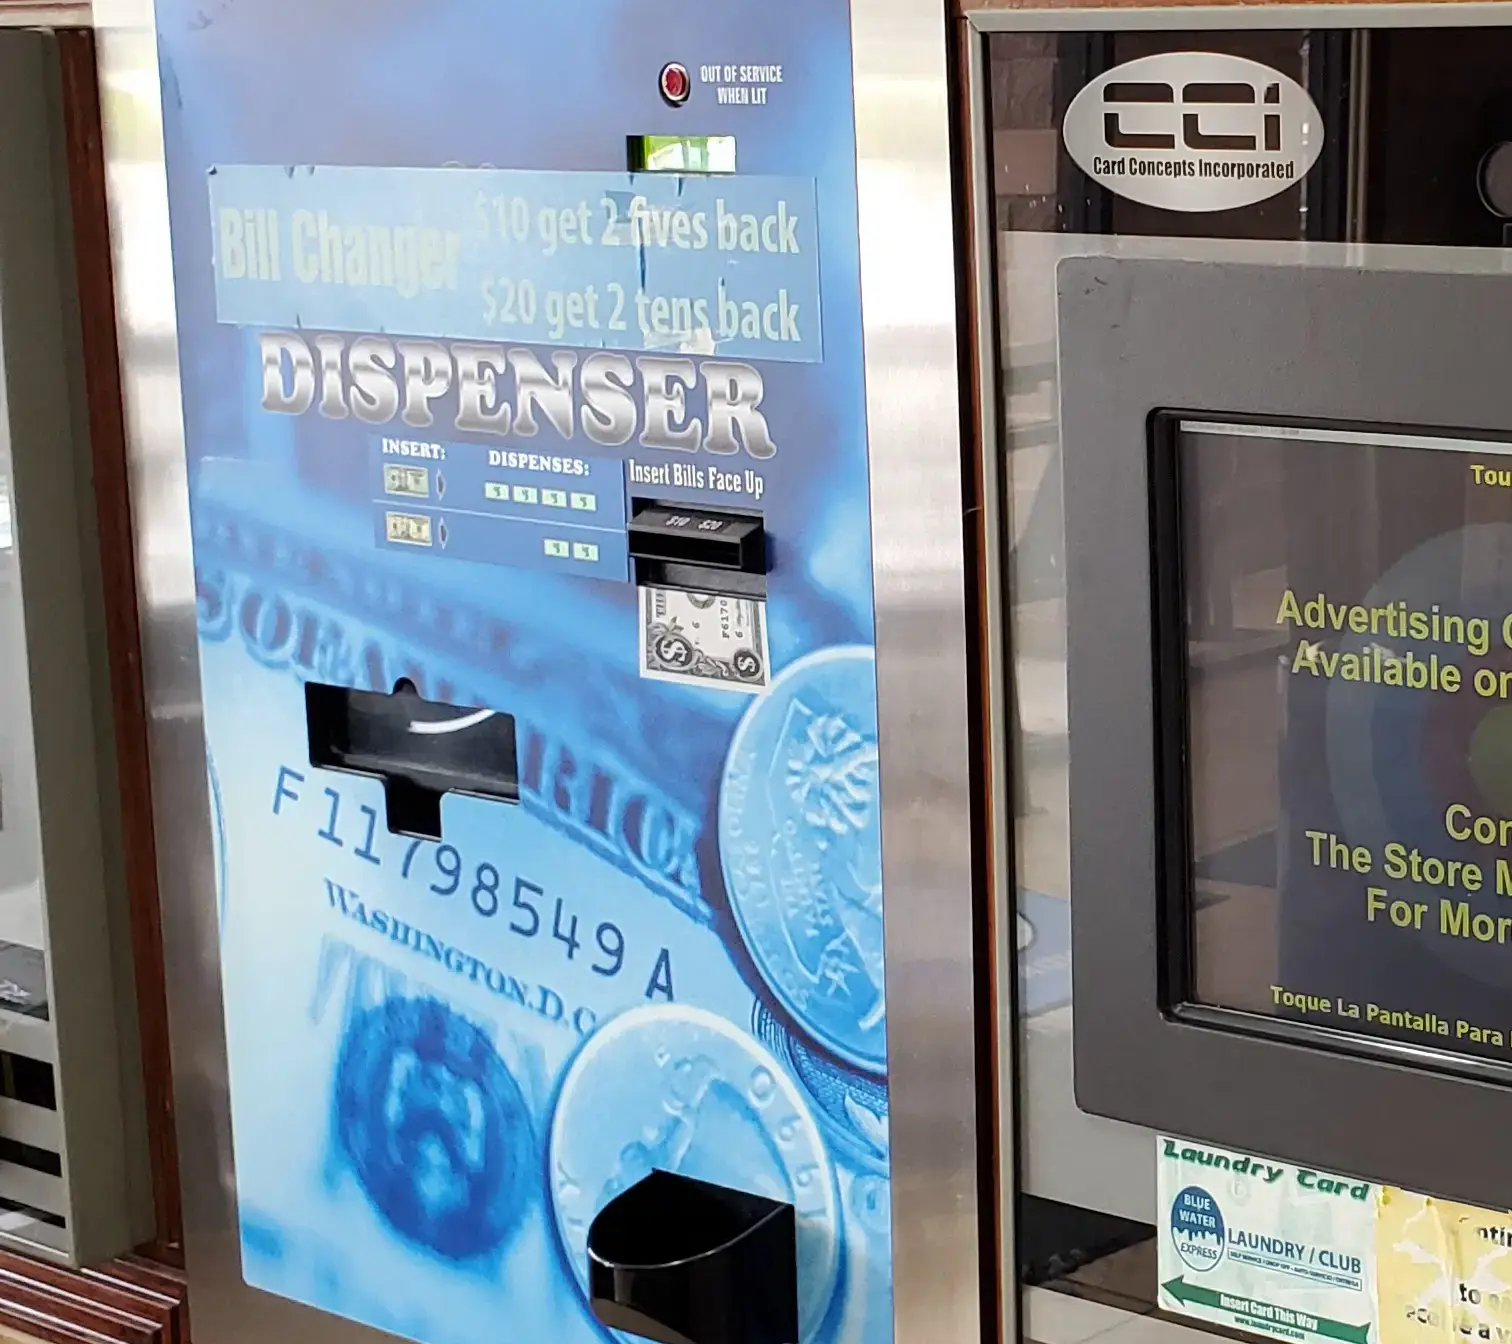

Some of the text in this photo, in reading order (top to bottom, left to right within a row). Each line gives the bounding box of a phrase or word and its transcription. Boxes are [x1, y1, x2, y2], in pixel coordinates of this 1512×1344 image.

[700, 65, 784, 84] OUT OF SERVICE
[717, 87, 767, 105] WHEN LIT
[1093, 156, 1295, 180] Card Concepts Incorporated
[474, 191, 800, 256] $10 get 2 fives back
[219, 207, 462, 299] Bill Changer
[481, 276, 802, 343] $20 get 2 tens back
[258, 330, 778, 458] DISPENSER
[382, 437, 591, 477] INSERT: DISPENSES:
[628, 458, 764, 500] Insert Bills Face Up
[1276, 589, 1491, 654] Advertising
[1291, 640, 1462, 694] Available
[1305, 830, 1373, 873] The
[1383, 843, 1483, 892] Store
[1366, 888, 1429, 930] For
[1270, 986, 1332, 1014] Toque
[1337, 997, 1361, 1020] La
[1366, 1002, 1451, 1036] Pantalla
[1456, 1020, 1504, 1047] Para
[1163, 1138, 1372, 1203] Laundry Card
[1178, 1208, 1217, 1229] WATER
[1183, 1193, 1212, 1211] BLUE
[1180, 1240, 1218, 1261] EXPRESS
[1228, 1227, 1306, 1262] LAUNDRY
[1318, 1249, 1362, 1275] CLUB
[1220, 1294, 1318, 1331] Insert Card This Way
[1459, 1282, 1482, 1306] to
